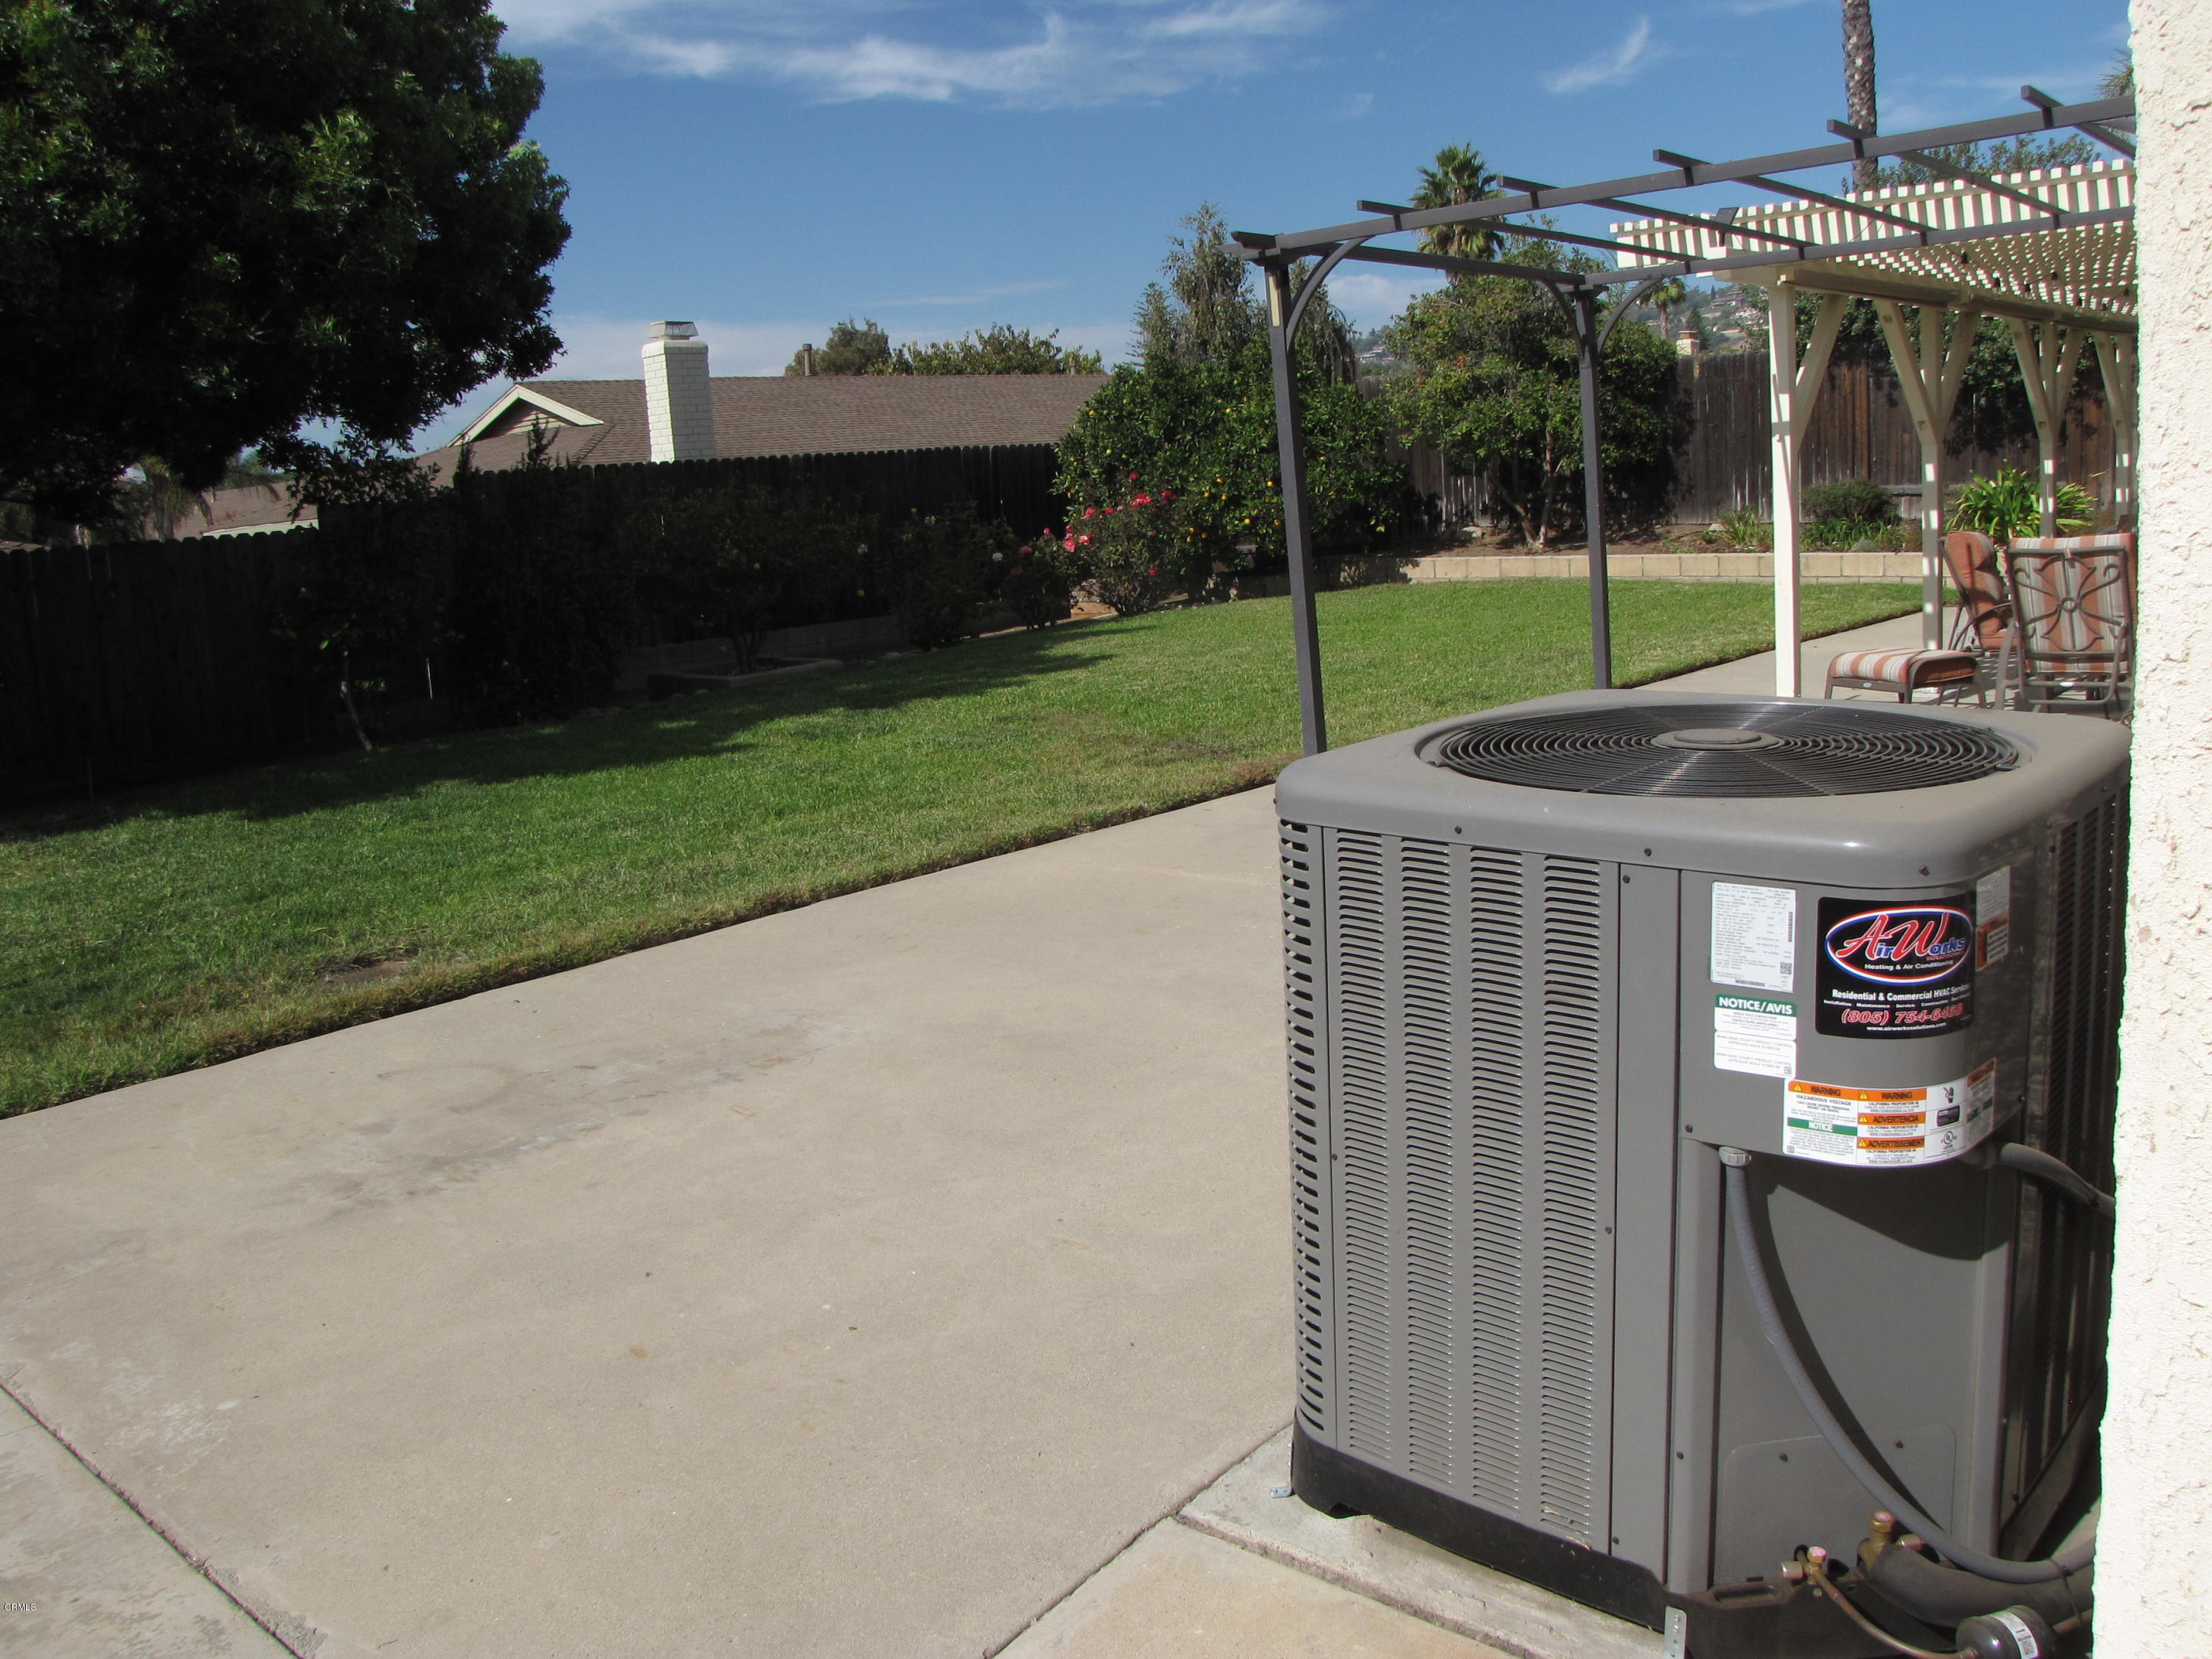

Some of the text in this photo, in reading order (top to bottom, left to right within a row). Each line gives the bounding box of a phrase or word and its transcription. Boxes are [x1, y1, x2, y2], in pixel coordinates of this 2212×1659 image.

[1835, 912, 1965, 961] AirWorks
[1865, 963, 1893, 971] Heating
[1915, 959, 1954, 970] Conditioning
[1832, 989, 1877, 1001] Residential
[1878, 992, 1885, 1001] &
[1887, 992, 1932, 1001] Commercial
[1933, 988, 1950, 998] HVAC
[1719, 996, 1792, 1015] NOTICE/AVIS
[1841, 1008, 1889, 1026] (805)
[1810, 1085, 1840, 1096] WARNING
[1881, 1091, 1913, 1099] WARNING
[1796, 1094, 1827, 1102] HAZARDOUS
[1872, 1115, 1919, 1123] ADVERTENCIA
[1808, 1121, 1834, 1133] NOTICE
[1868, 1138, 1924, 1148] ADVERTISSEMENT
